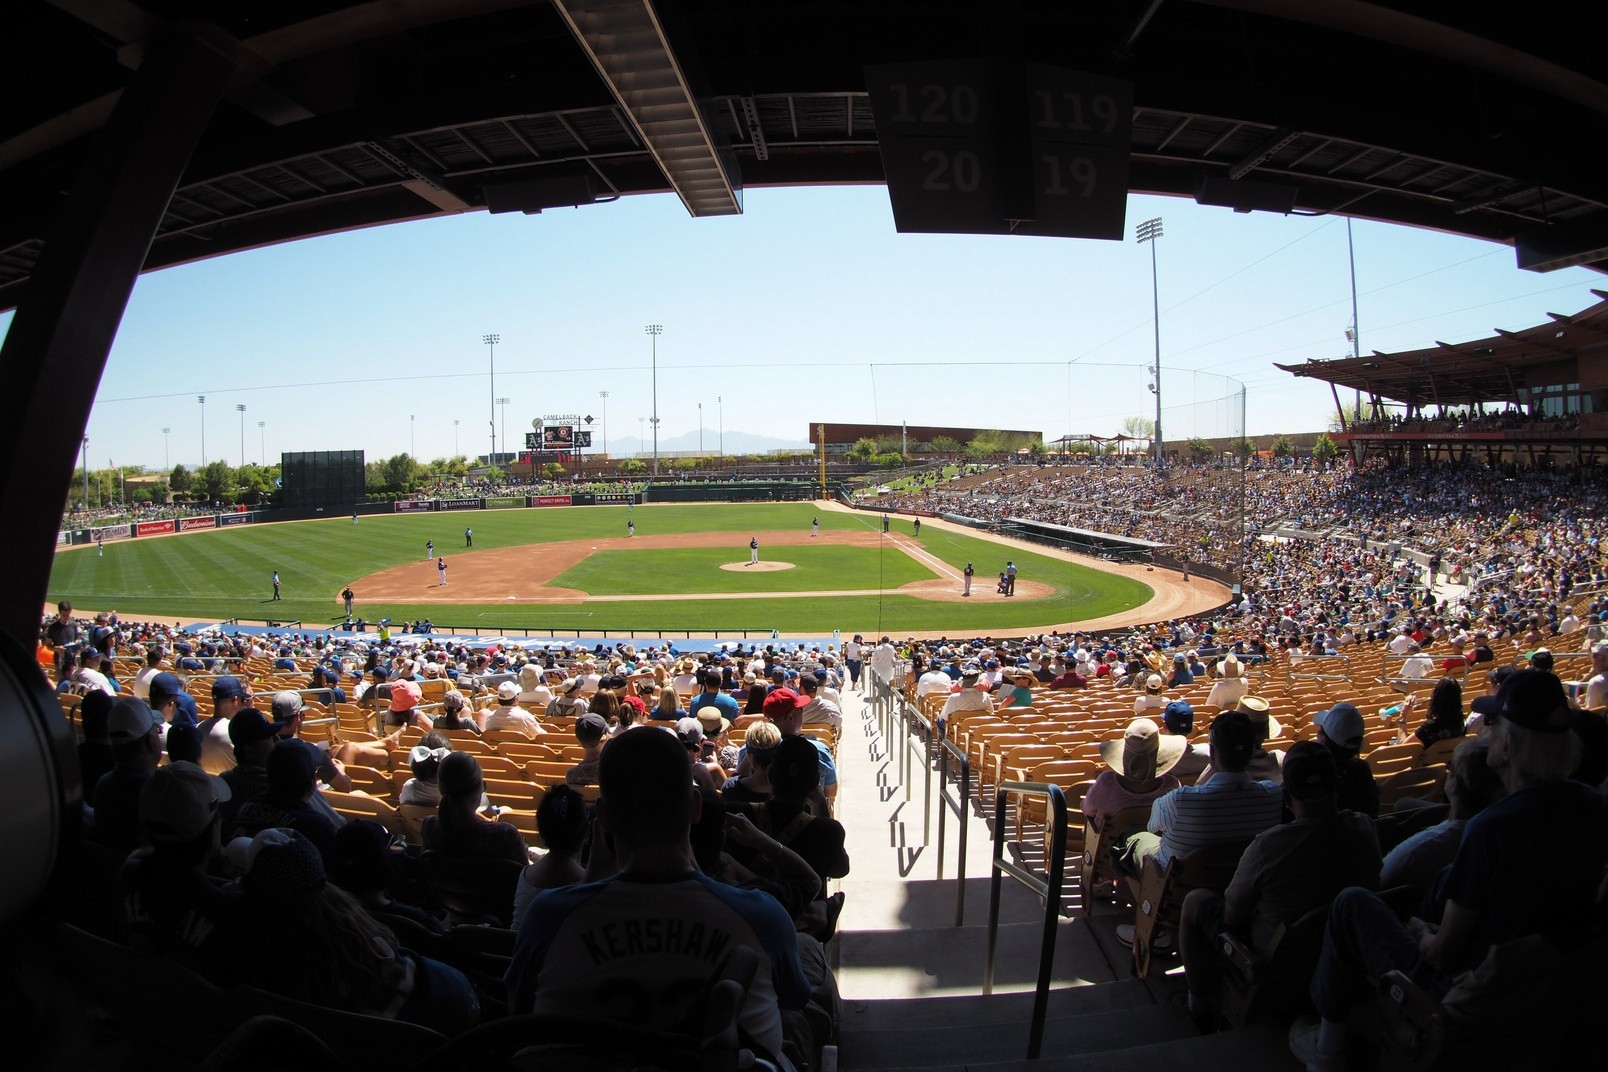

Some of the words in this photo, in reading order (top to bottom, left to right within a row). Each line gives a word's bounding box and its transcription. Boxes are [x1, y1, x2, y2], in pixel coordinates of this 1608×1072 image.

[890, 83, 979, 124] 120
[1035, 91, 1118, 134] 119
[921, 150, 981, 192] 20
[1042, 154, 1098, 198] 19
[180, 519, 215, 530] Budweiser
[581, 919, 730, 965] KERSHAW
